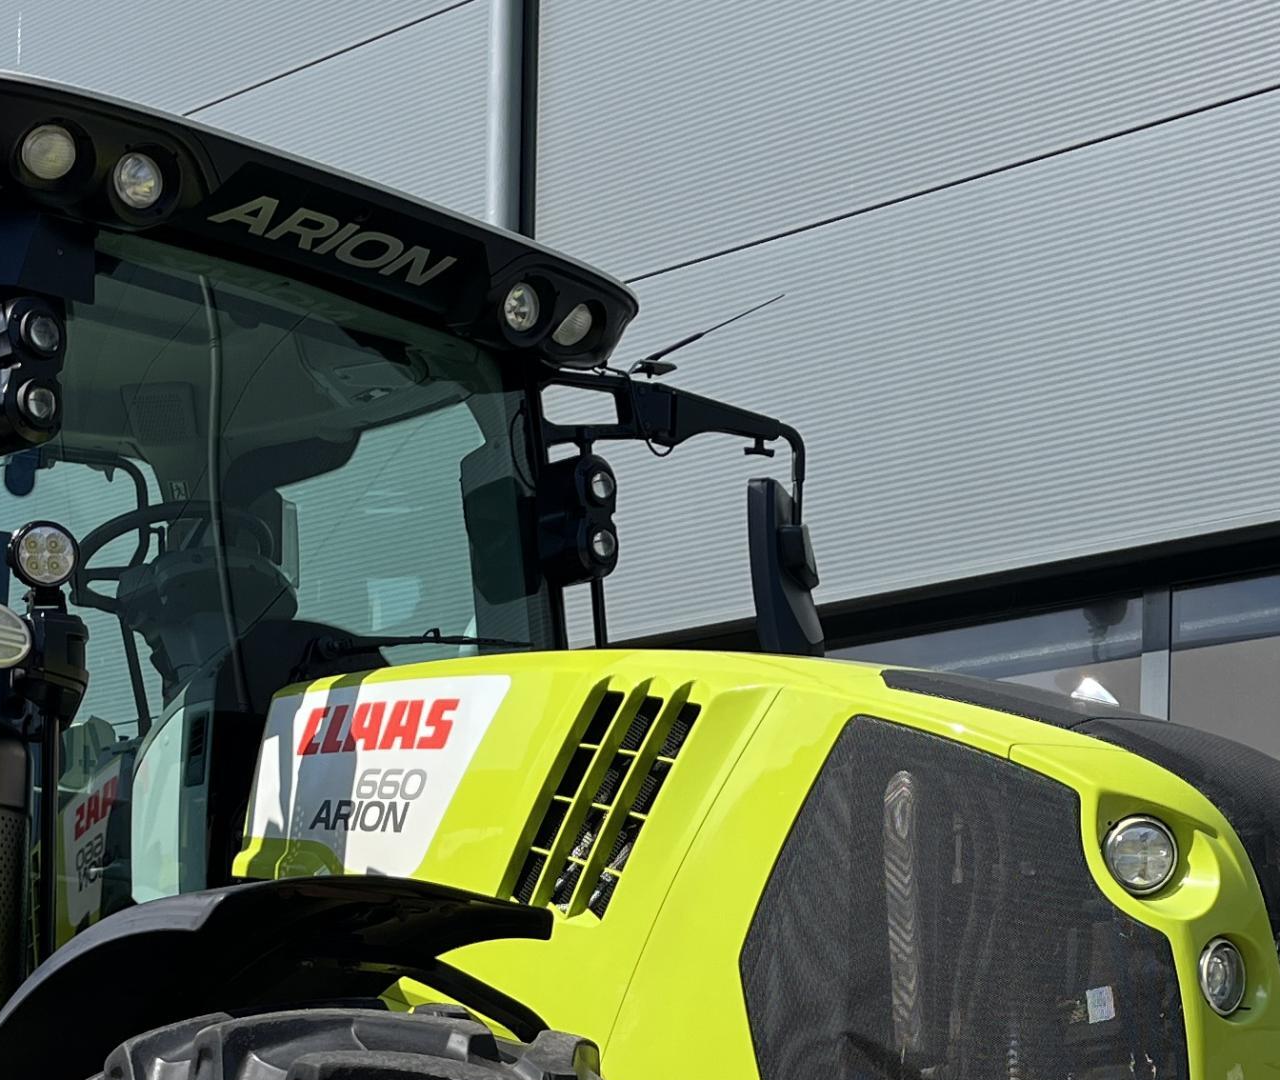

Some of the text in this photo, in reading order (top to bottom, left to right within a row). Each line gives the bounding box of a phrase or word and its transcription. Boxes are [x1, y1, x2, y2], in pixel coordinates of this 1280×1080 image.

[209, 196, 458, 286] ARION
[296, 698, 461, 756] CLAAS
[355, 768, 428, 801] 660
[308, 799, 411, 833] ARION
